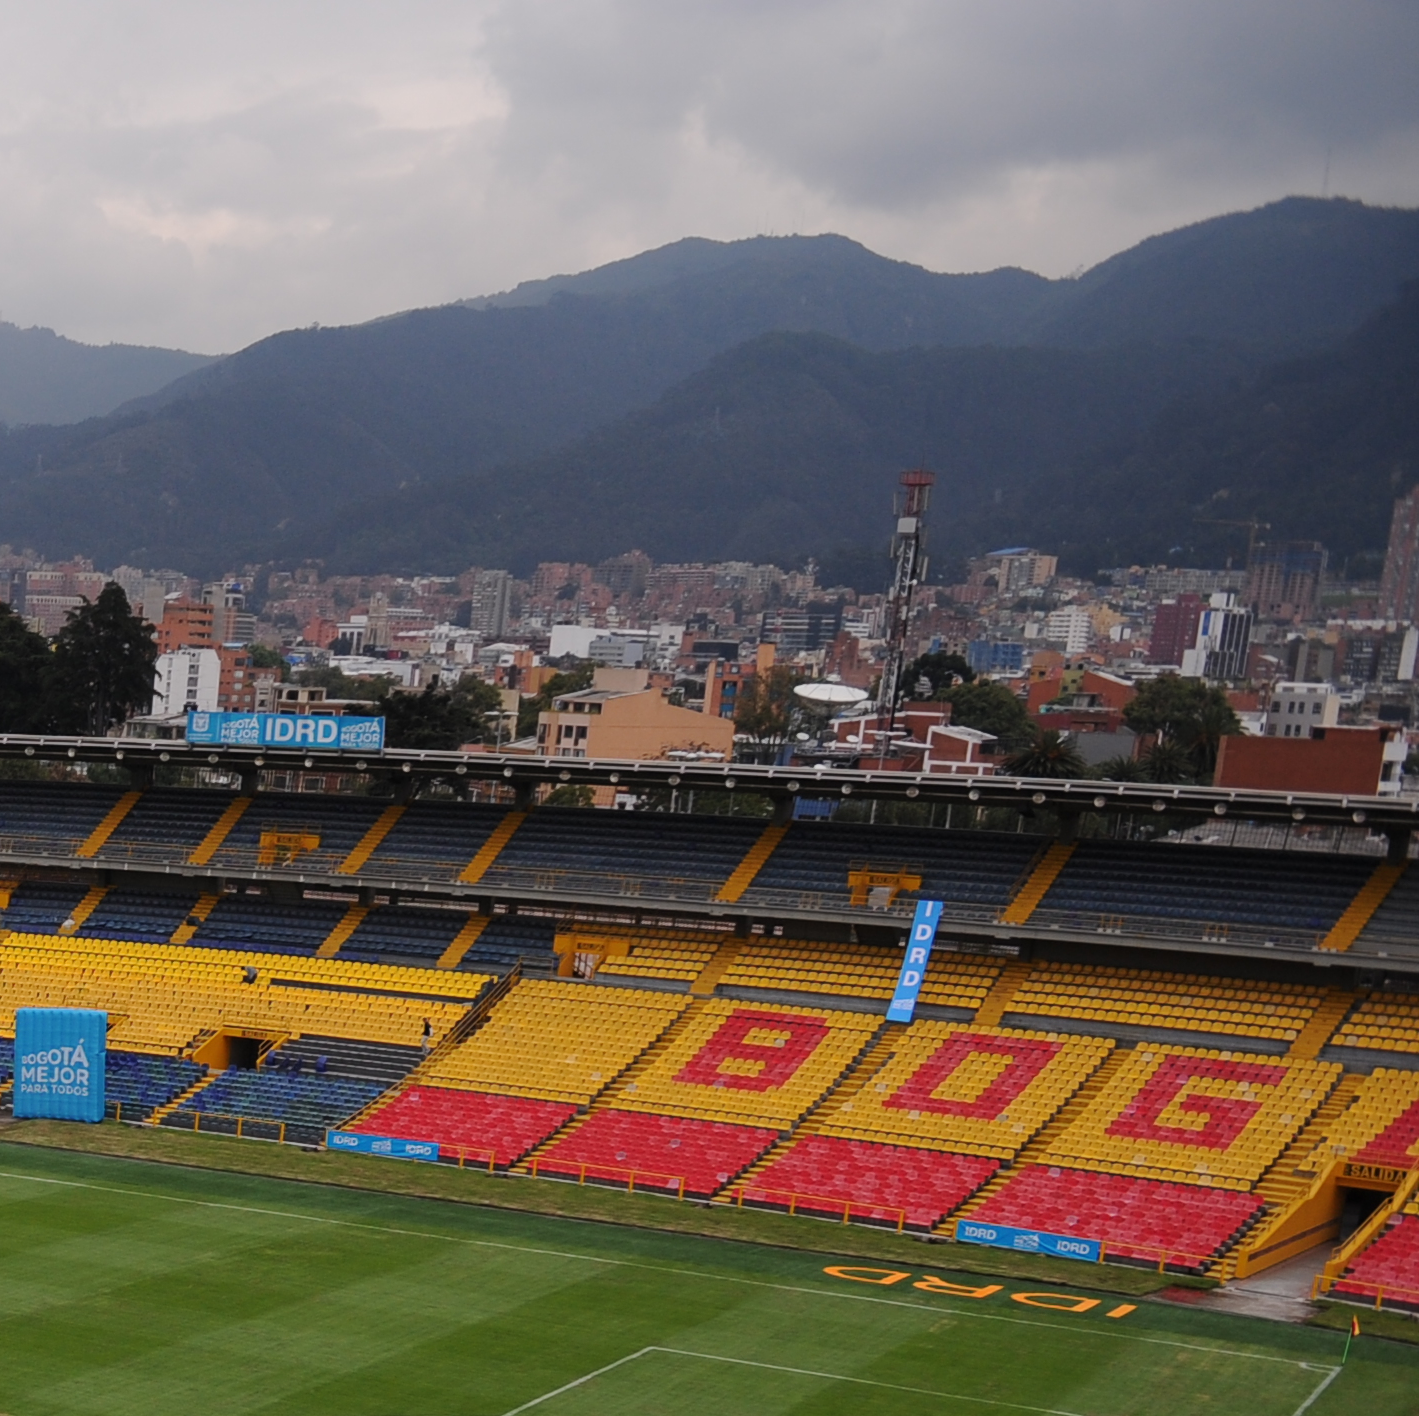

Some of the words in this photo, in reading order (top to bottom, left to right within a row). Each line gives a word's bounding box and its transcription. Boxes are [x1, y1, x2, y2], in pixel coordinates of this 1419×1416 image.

[221, 714, 260, 729] BOGOTÁ
[265, 717, 339, 743] IDRD
[341, 717, 381, 733] BOGOTÁ
[221, 729, 260, 739] MEJOR
[340, 732, 381, 743] MEJOR
[903, 901, 933, 987] IDRD
[21, 1038, 89, 1068] BOGOTÁ
[21, 1066, 89, 1086] MEJOR
[21, 1083, 49, 1094] PARA
[51, 1084, 89, 1097] TODOS
[333, 1135, 359, 1146] IDRD
[405, 1144, 432, 1156] IDRD
[1350, 1164, 1405, 1182] SALIDA
[965, 1226, 997, 1240] IDRD
[1057, 1240, 1090, 1255] IDRD
[823, 1266, 1138, 1318] IDRD
